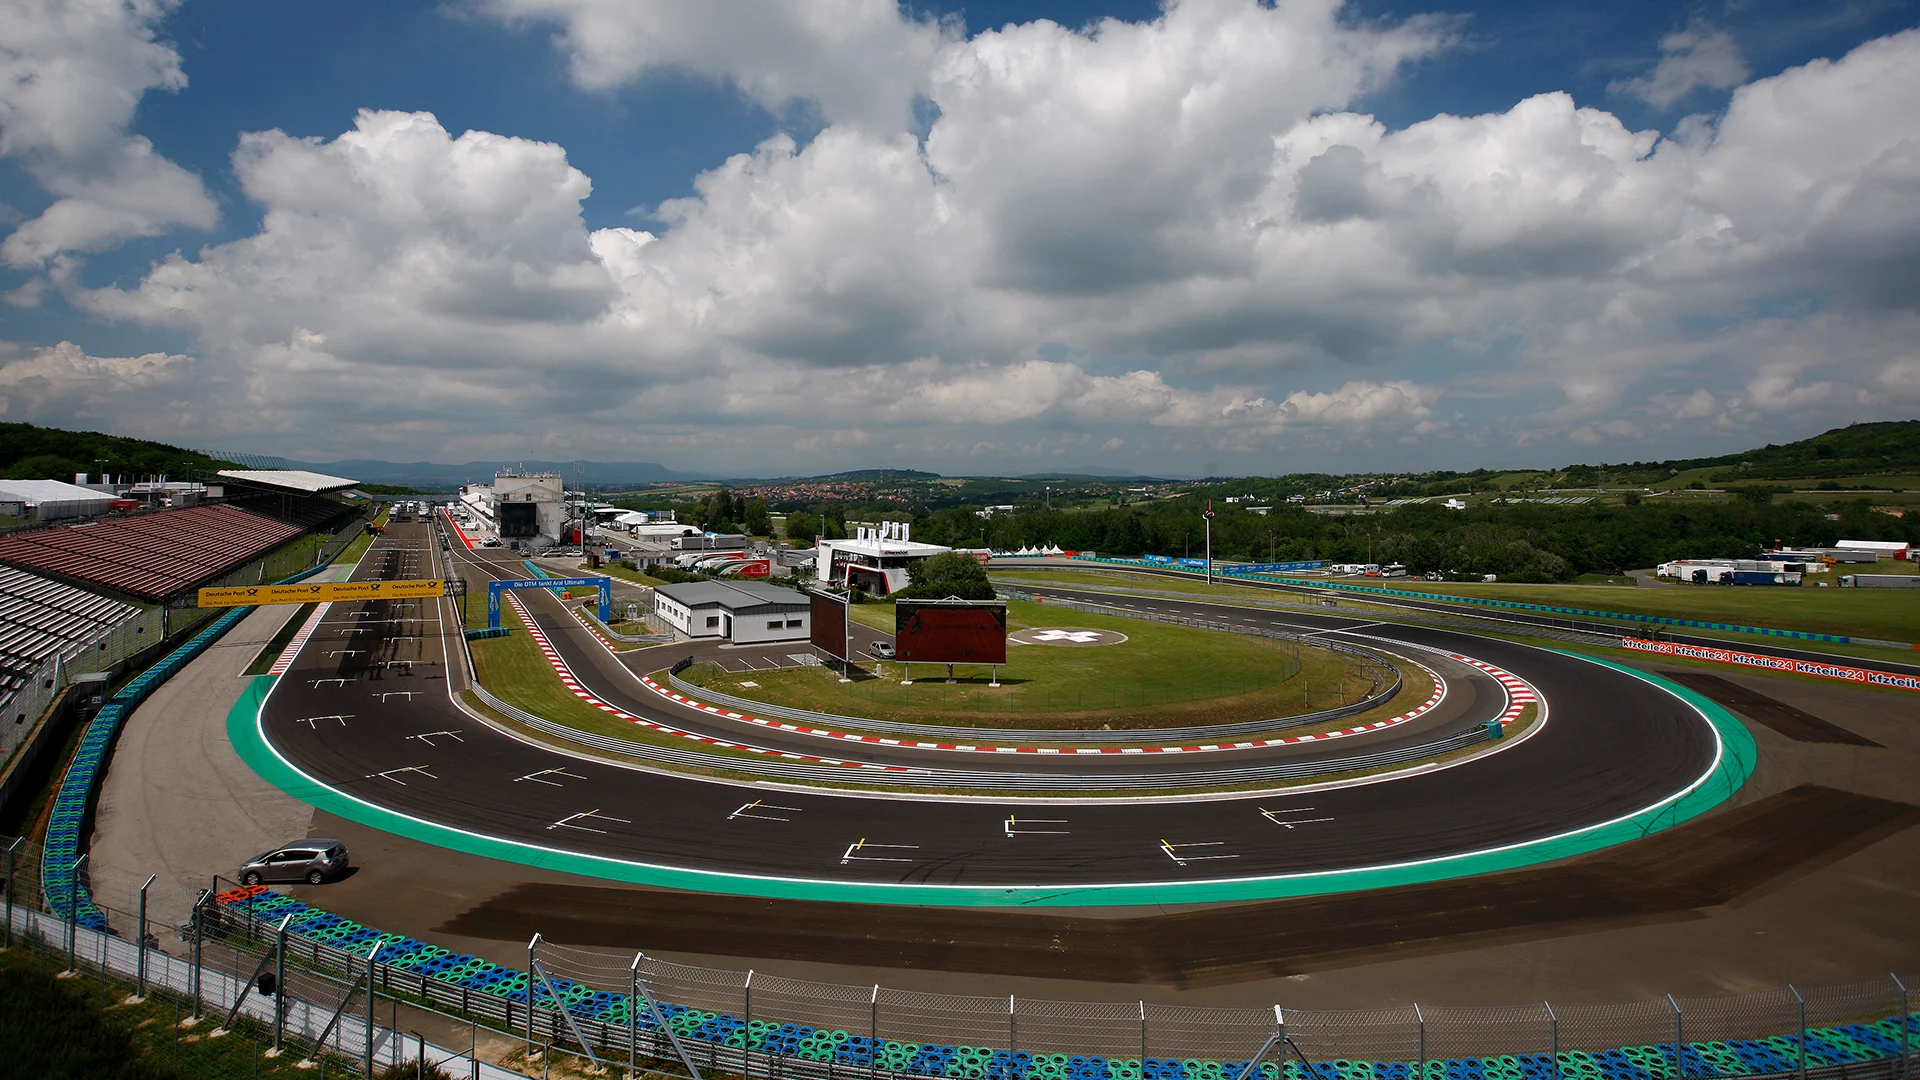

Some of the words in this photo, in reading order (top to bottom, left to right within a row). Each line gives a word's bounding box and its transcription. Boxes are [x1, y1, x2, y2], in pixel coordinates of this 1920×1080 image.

[1622, 640, 1672, 654] kfzteile24
[1675, 646, 1730, 661] kfzteile24
[1732, 654, 1793, 670] kfzteile24
[1796, 663, 1864, 680] kfzteile24
